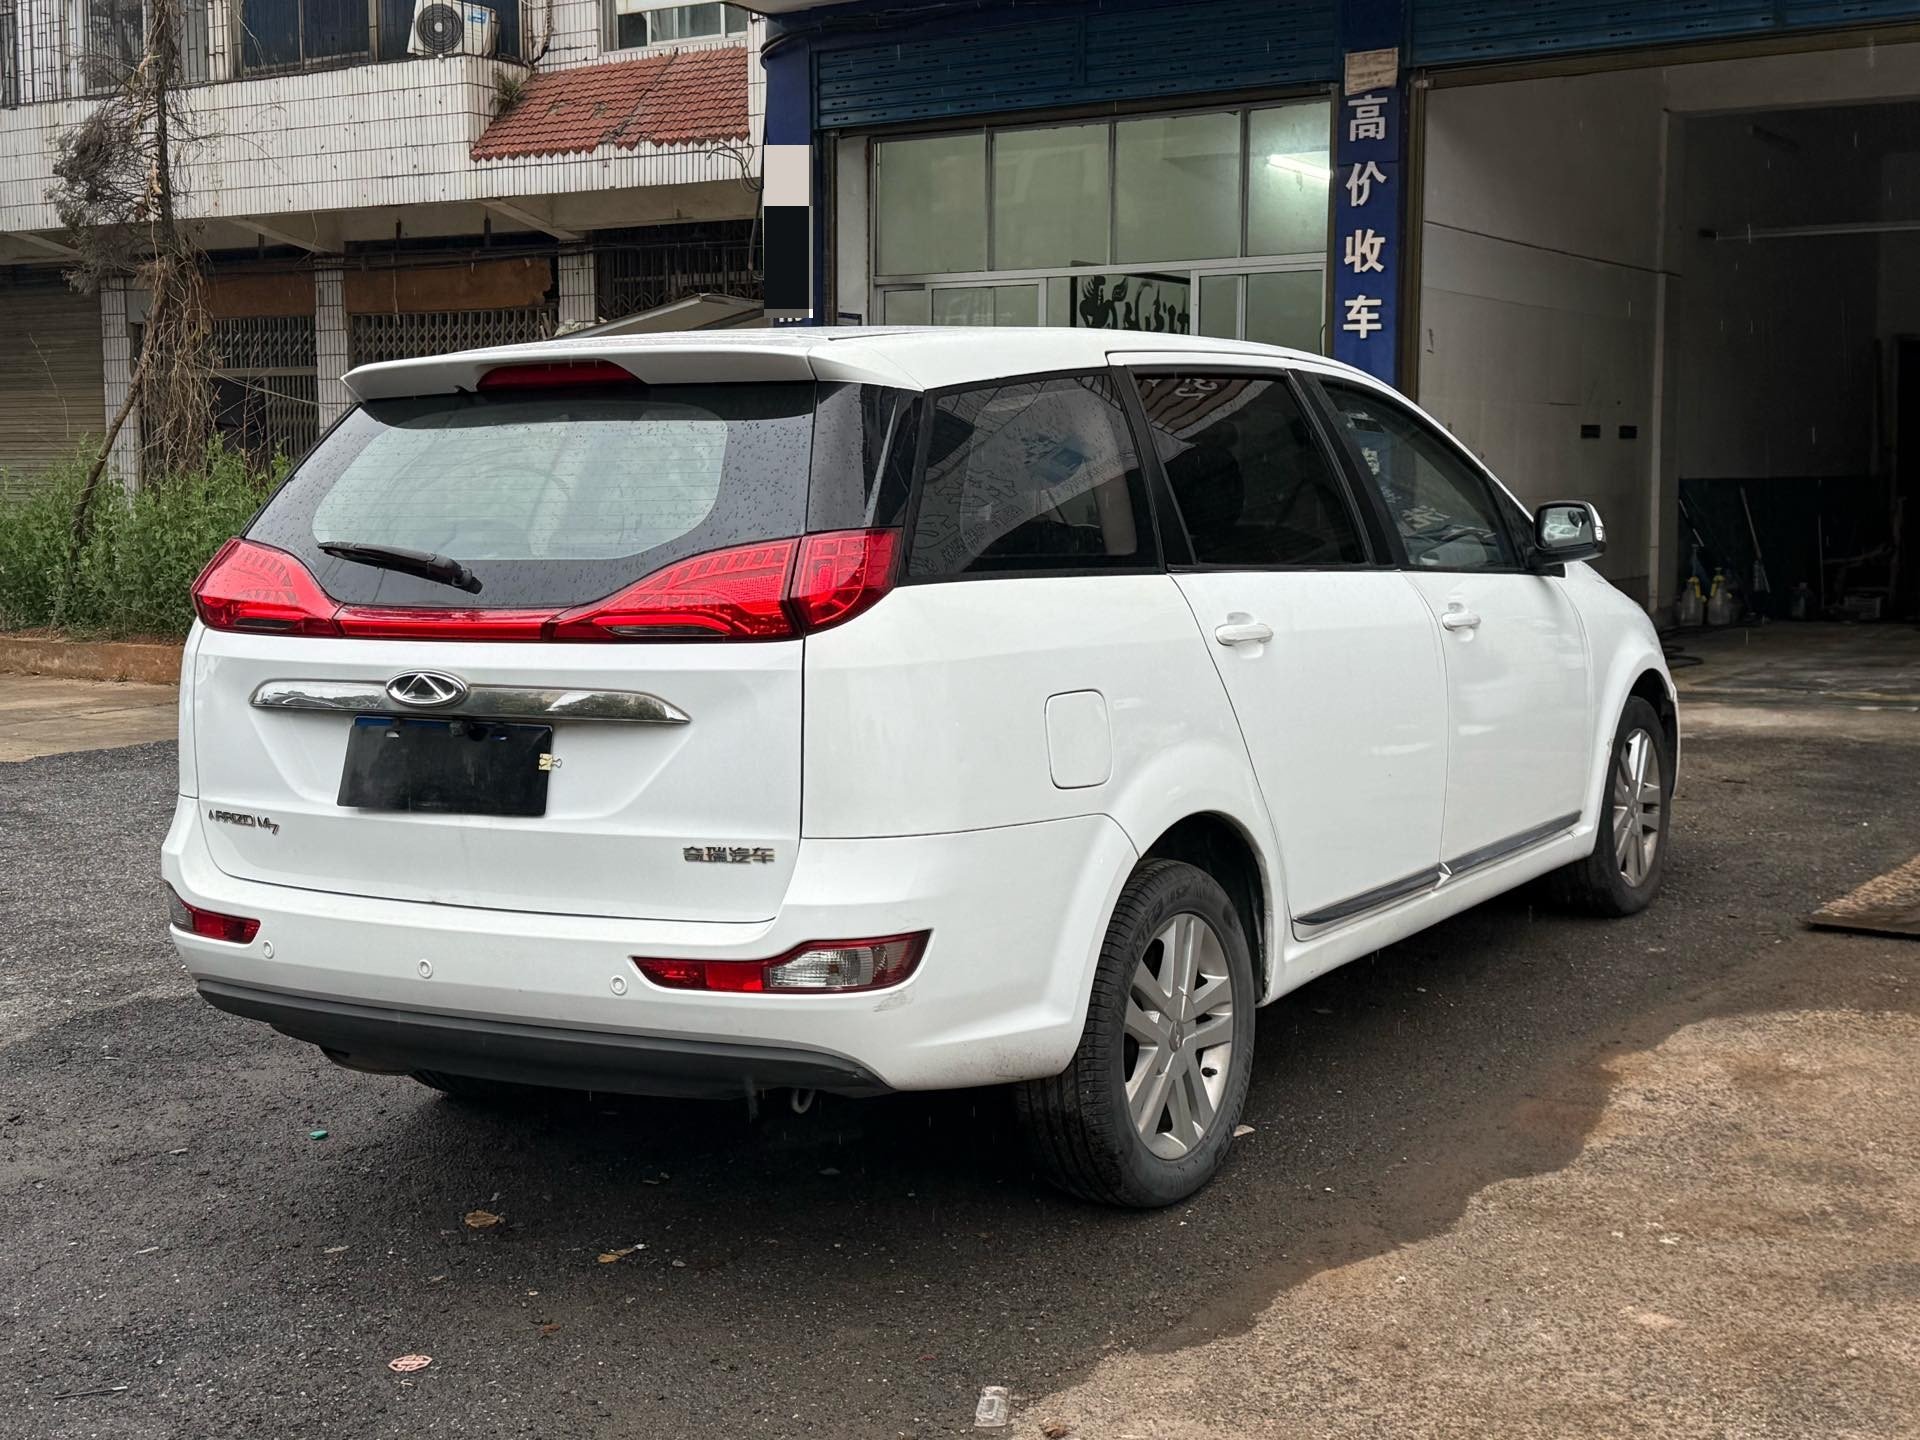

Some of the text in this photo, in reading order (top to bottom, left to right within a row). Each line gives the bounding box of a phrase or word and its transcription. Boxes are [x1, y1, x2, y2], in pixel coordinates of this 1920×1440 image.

[1343, 95, 1388, 339] 高价收车
[683, 846, 775, 864] 奇瑞汽车
